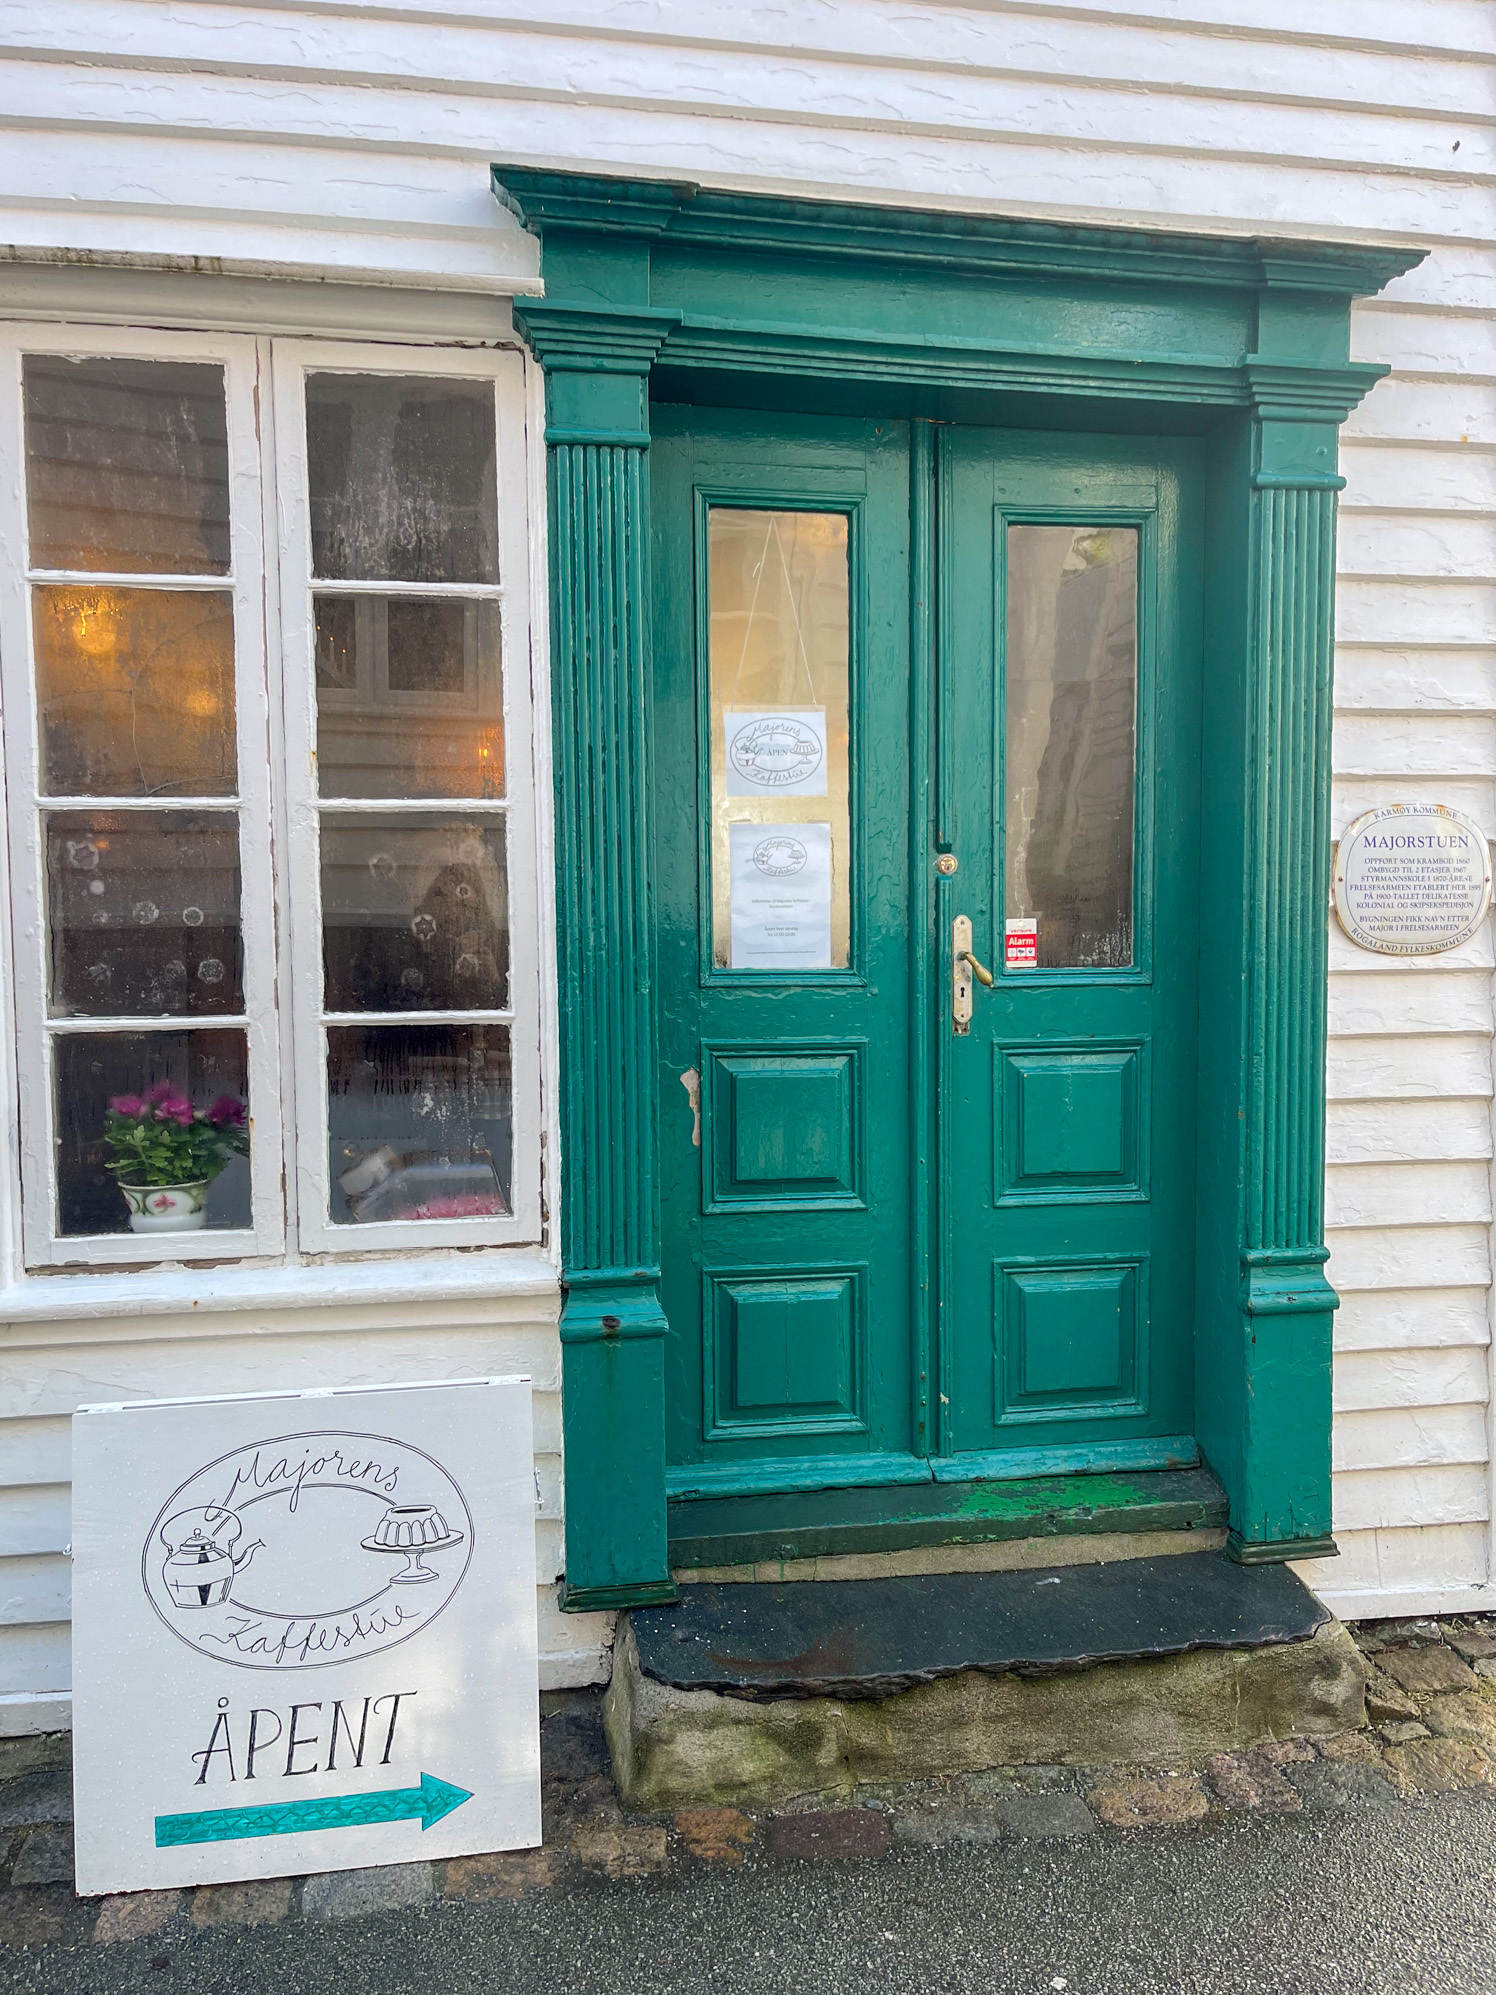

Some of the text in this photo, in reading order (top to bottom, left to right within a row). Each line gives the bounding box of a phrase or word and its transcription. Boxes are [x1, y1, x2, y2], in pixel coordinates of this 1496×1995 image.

[746, 722, 800, 742] Majorens
[767, 747, 788, 756] ÅPEN
[1374, 806, 1458, 820] KARMØY KOMMUNE
[1364, 836, 1469, 850] MAJORSTUEN
[1008, 937, 1034, 945] Alarm
[1351, 927, 1473, 952] ROGALAND FYLKESKOMMUNE
[204, 1449, 400, 1522] Majorens
[192, 1690, 418, 1785] ÅPENT
